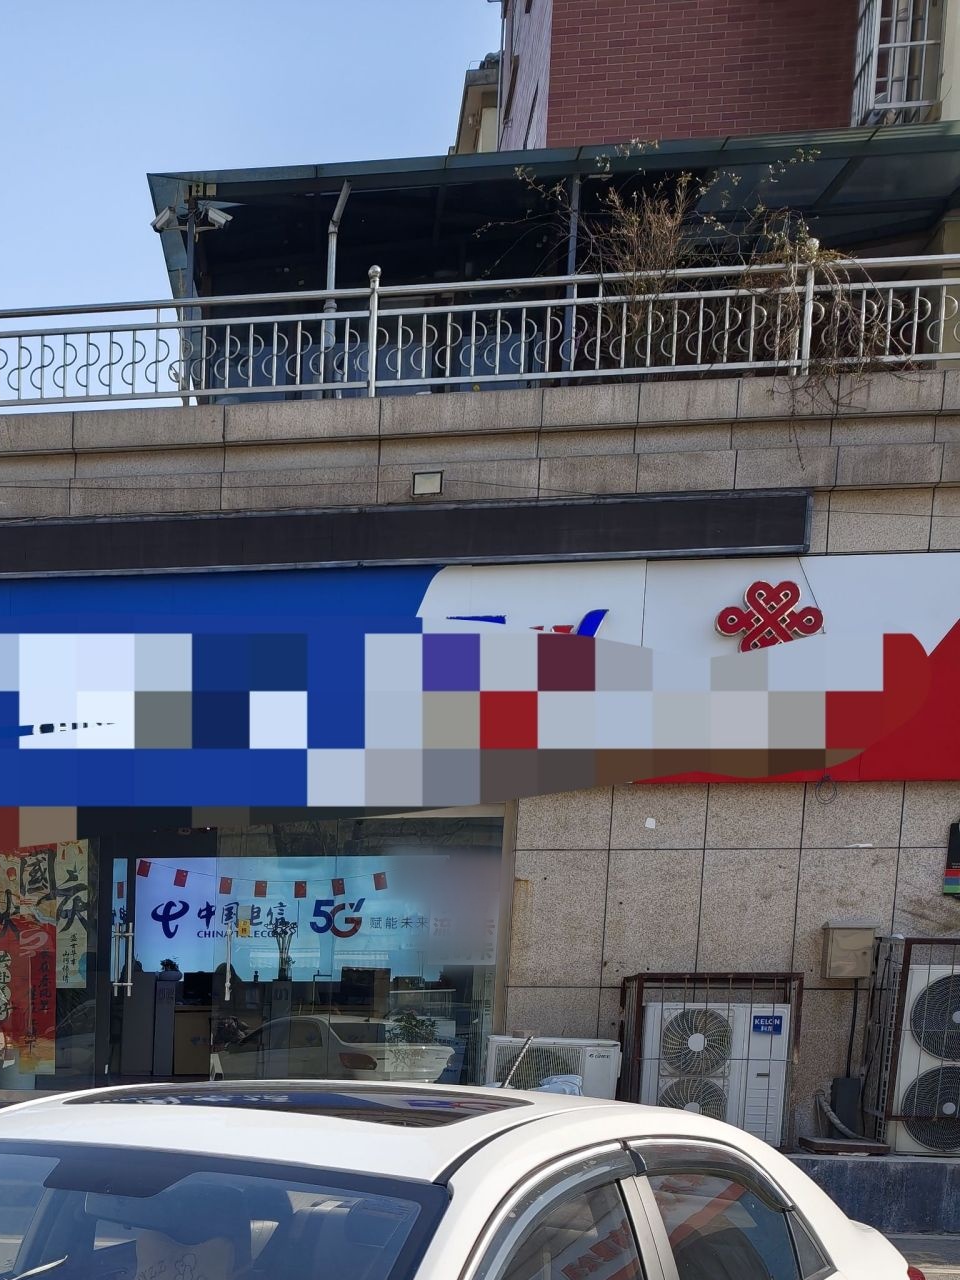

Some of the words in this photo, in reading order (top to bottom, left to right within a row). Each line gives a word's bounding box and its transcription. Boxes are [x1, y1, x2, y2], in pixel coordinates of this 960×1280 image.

[197, 901, 287, 929] 中国电信
[310, 898, 366, 939] 5G
[370, 916, 429, 930] 赋能未来
